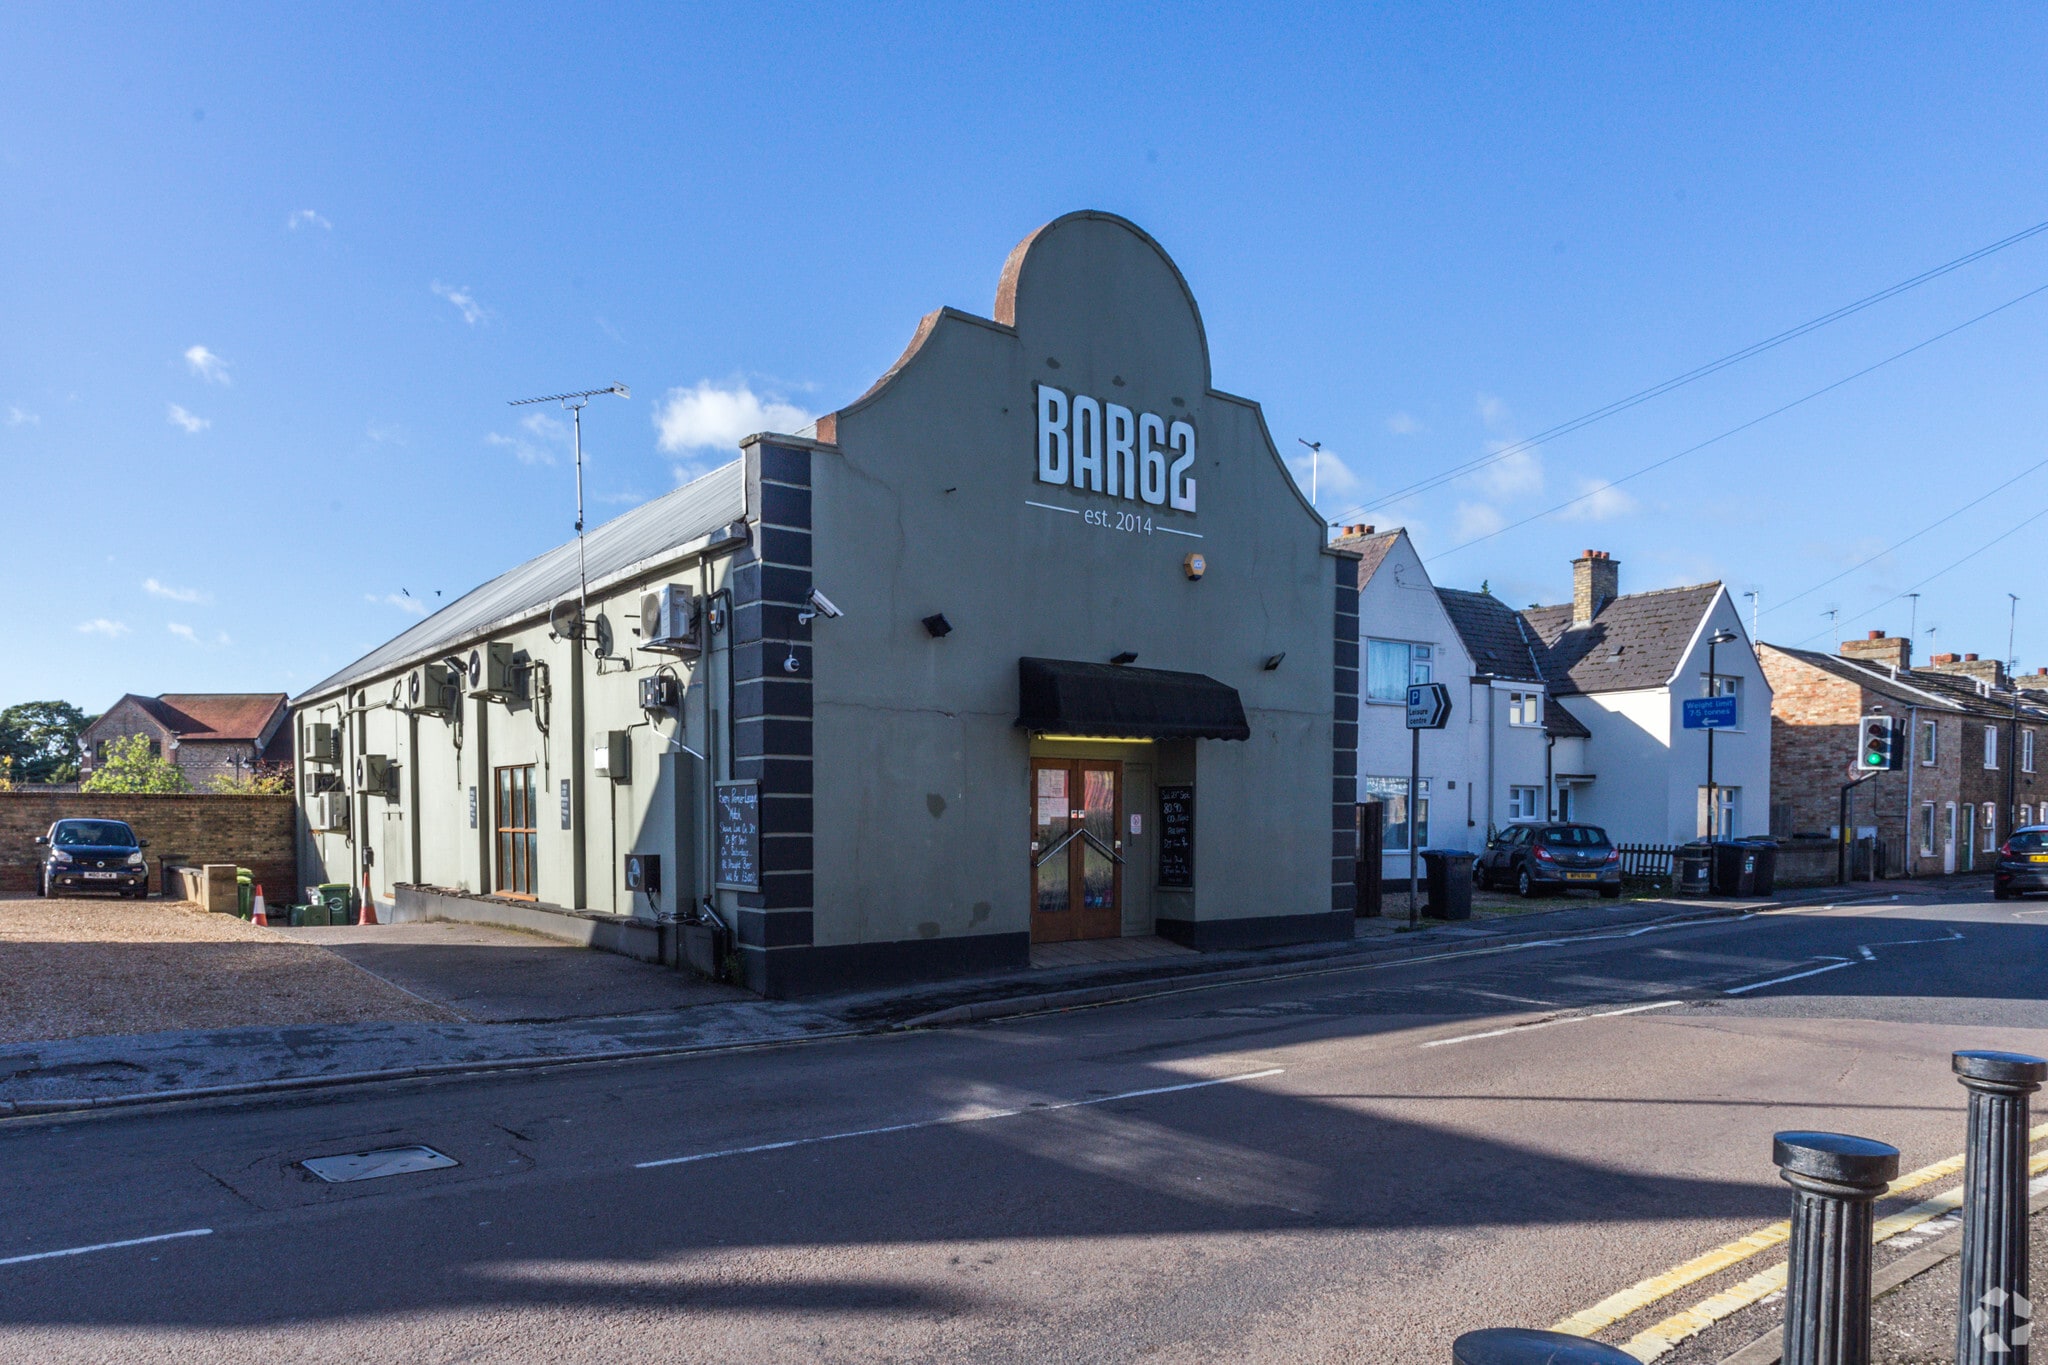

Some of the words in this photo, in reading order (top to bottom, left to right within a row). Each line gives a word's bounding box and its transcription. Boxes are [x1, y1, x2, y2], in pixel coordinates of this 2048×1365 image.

[1038, 384, 1196, 513] BAR62
[1084, 508, 1111, 528] est.
[1115, 511, 1153, 536] 2014
[1686, 701, 1713, 709] Weight
[1409, 717, 1427, 725] centre
